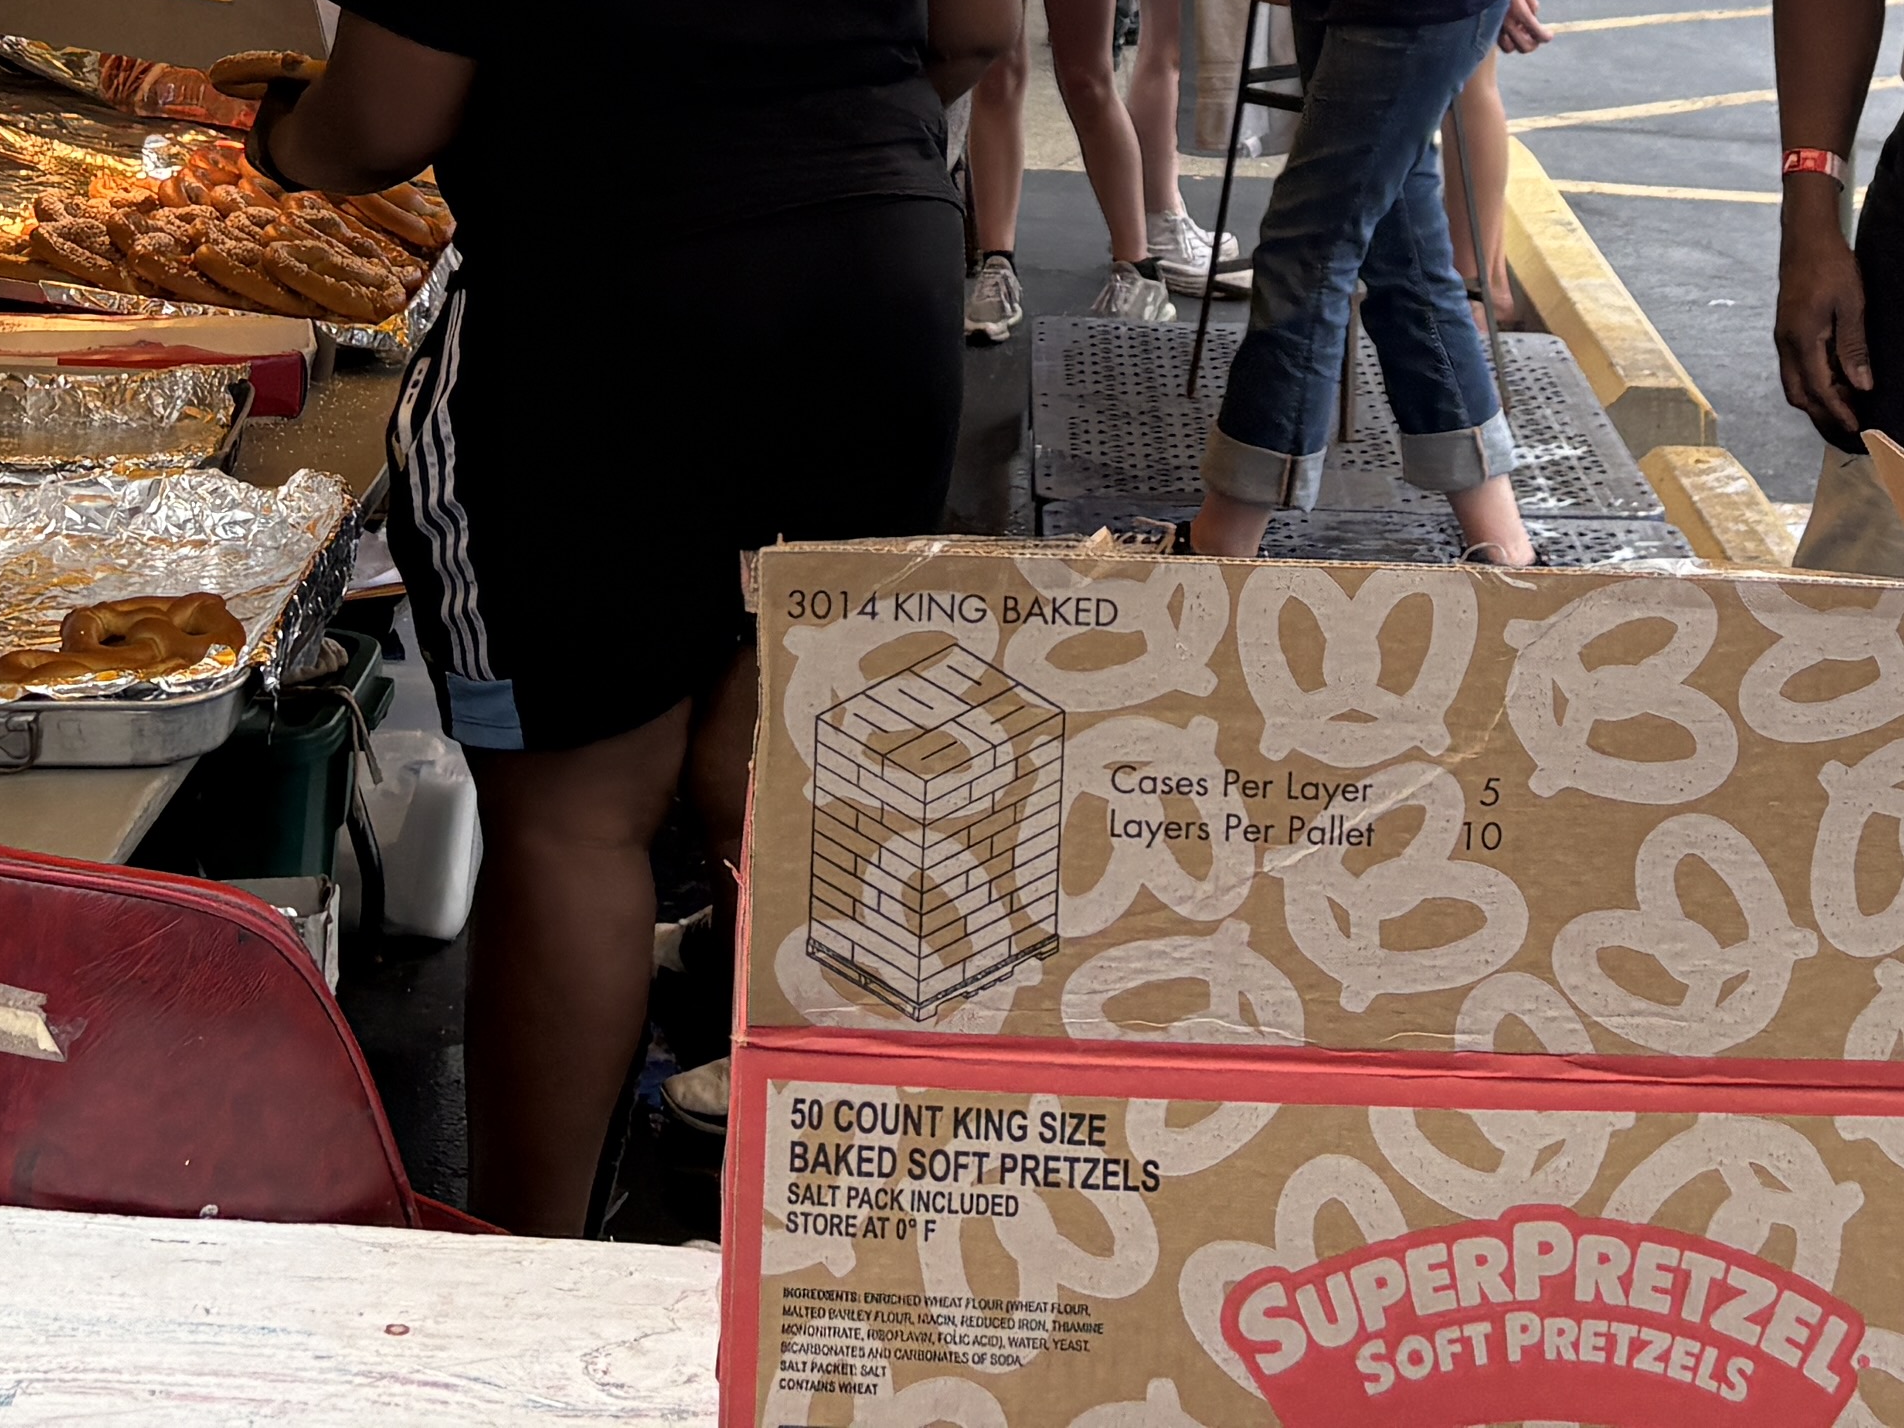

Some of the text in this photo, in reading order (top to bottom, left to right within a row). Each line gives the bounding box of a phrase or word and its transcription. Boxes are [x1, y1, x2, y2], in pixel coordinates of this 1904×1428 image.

[787, 588, 1120, 630] 3014 KING BAKED
[1110, 763, 1502, 813] Cases Per Layer 5
[1108, 807, 1503, 852] Layers Per Pallet 10
[790, 1097, 1107, 1147] 50 COUNT KING SIZE
[789, 1140, 1161, 1193] BAKED SOFT PRETZELS
[787, 1182, 1019, 1217] SALT PACK INCLUDED
[785, 1211, 857, 1238] STORE
[862, 1216, 891, 1240] AT
[925, 1219, 937, 1242] F
[782, 1304, 826, 1319] MALTED
[828, 1307, 872, 1322] BARLEY
[960, 1315, 1015, 1330] REDUCED
[1052, 1320, 1104, 1335] THIAMINE
[924, 1295, 963, 1309] WHEAT
[964, 1297, 1003, 1312] FLOUR
[1238, 1220, 1848, 1394] SUPERPRETZEL
[780, 1360, 807, 1373] SALT
[860, 1364, 887, 1377] SALT
[868, 1347, 892, 1360] AND
[894, 1348, 969, 1364] CARBONATES
[971, 1353, 988, 1366] OF
[1355, 1310, 1755, 1402] SOFT PRETZELS
[779, 1378, 878, 1395] CONTAINS WHEAT
